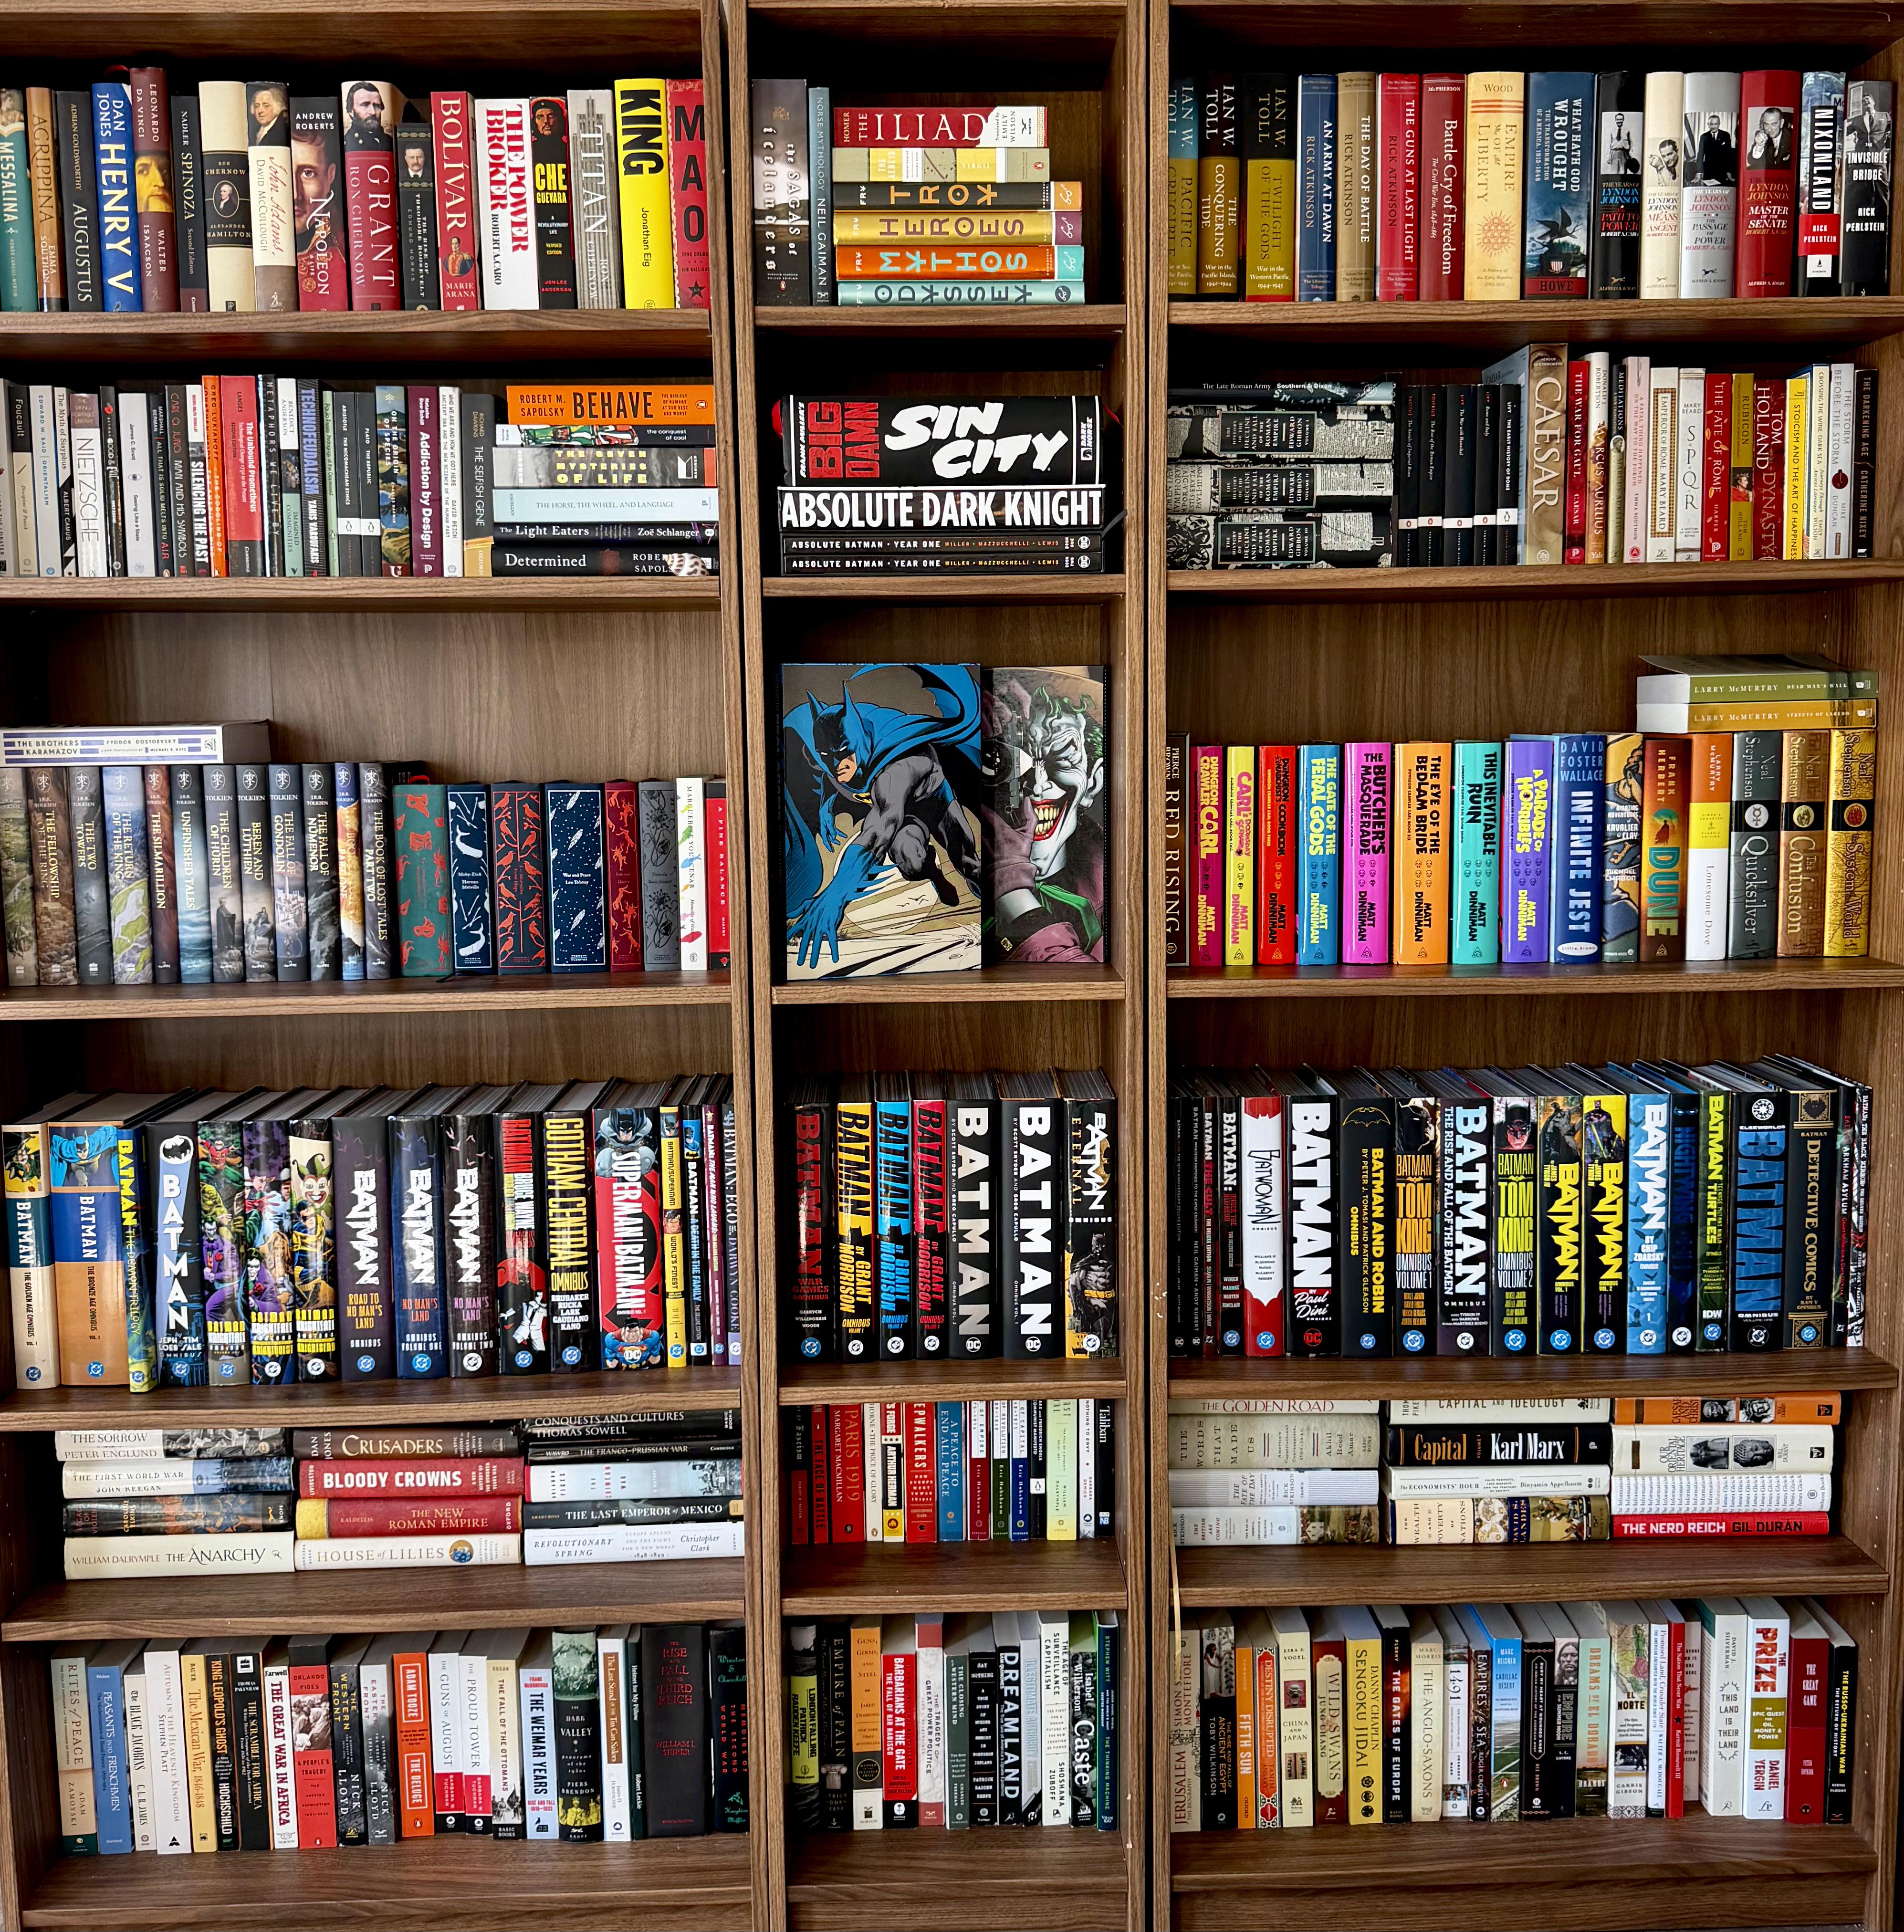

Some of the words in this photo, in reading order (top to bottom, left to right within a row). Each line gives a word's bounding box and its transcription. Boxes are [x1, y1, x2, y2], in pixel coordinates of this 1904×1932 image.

[620, 89, 664, 177] KING
[858, 113, 868, 140] THE
[875, 113, 987, 141] ILIAD
[1324, 120, 1332, 138] AN
[1445, 119, 1458, 161] Battle
[1553, 99, 1568, 191] WROUGHT
[32, 115, 54, 224] AGRIPPINA
[440, 98, 467, 231] BOLÍVAR
[1324, 143, 1332, 179] ARMY
[1812, 109, 1834, 210] NIXONLAND
[1848, 151, 1887, 163] INVISIBLE
[1853, 169, 1882, 180] BRIDGE
[181, 153, 196, 221] SPINOZA
[535, 163, 567, 190] CHE
[580, 125, 607, 236] TITAN
[1324, 183, 1332, 200] AT
[1440, 165, 1458, 193] Cry
[100, 144, 132, 257] HENRY
[536, 192, 567, 204] GUEVARA
[1444, 196, 1457, 210] of
[367, 164, 395, 287] GRANT
[641, 207, 649, 251] Jonathan
[879, 219, 1024, 236] HEROES
[1322, 203, 1332, 243] DAWN
[73, 203, 92, 303] AUGUSTUS
[310, 190, 330, 295] NAPOLEON
[641, 253, 650, 268] Eig
[1442, 213, 1457, 276] Freedom
[108, 269, 134, 294] V
[15, 398, 24, 437] Foucault
[520, 395, 551, 404] ROBERT
[554, 394, 566, 403] M.
[521, 407, 565, 417] SAPOLSKY
[573, 391, 653, 419] BEHAVE
[808, 402, 843, 478] BIG
[845, 402, 880, 478] DAMN
[885, 402, 1004, 450] SIN
[1756, 387, 1769, 470] HOLLAND
[1772, 409, 1782, 445] TOM
[419, 431, 430, 489] Addiction
[932, 430, 1068, 478] CITY
[1532, 376, 1562, 514] CAESAR
[76, 438, 99, 543] NIETZSCHE
[419, 491, 430, 504] by
[420, 504, 432, 548] Design
[782, 492, 914, 528] ABSOLUTE
[923, 492, 997, 526] DARK
[1005, 491, 1101, 525] KNIGHT
[515, 525, 547, 536] Light
[551, 526, 589, 536] Eaters
[638, 528, 654, 537] Zoë
[657, 528, 700, 539] Schlanger
[505, 553, 586, 567] Determined
[1729, 684, 1778, 692] McMURTRY
[1560, 741, 1603, 752] DAVID
[1560, 755, 1603, 766] FOSTER
[1416, 755, 1427, 813] BEDLAM
[1560, 770, 1603, 781] WALLACE
[1360, 765, 1372, 856] MASQUERADE
[1372, 764, 1387, 855] BUTCHER'S
[1466, 783, 1481, 824] RUIN
[1483, 779, 1496, 856] INEVITABLE
[181, 812, 193, 876] UNFINISHED
[1416, 814, 1427, 855] BRIDE
[1569, 790, 1593, 879] INFINITE
[183, 878, 195, 909] TALES
[1647, 846, 1680, 936] DUNE
[1705, 866, 1714, 915] Lonesome
[1568, 888, 1590, 933] JEST
[1704, 920, 1713, 945] Dove
[546, 1118, 586, 1191] GOTHAM
[1633, 1103, 1667, 1229] BATMAN
[1292, 1103, 1331, 1288] BATMAN
[1371, 1148, 1384, 1219] BATMAN
[1396, 1184, 1431, 1217] TOM
[1805, 1140, 1820, 1229] DETECTIVE
[79, 1196, 97, 1259] BATMAN
[345, 1169, 379, 1285] BATMAN
[549, 1197, 588, 1270] CENTRAL
[957, 1107, 989, 1335] BATMAN
[1019, 1107, 1051, 1335] BATMAN
[1350, 1206, 1358, 1256] OMNIBUS
[1396, 1218, 1431, 1253] KING
[1735, 1131, 1785, 1311] BATMAN
[162, 1174, 188, 1330] BATMAN
[1372, 1222, 1384, 1259] AND
[1633, 1253, 1664, 1262] ZDARSKY
[551, 1271, 588, 1291] OMNIBUS
[1804, 1233, 1819, 1292] COMICS
[1294, 1293, 1327, 1306] Paul
[1372, 1260, 1384, 1313] ROBIN
[1297, 1305, 1329, 1319] Dini
[1703, 1310, 1722, 1319] IDW
[1099, 1406, 1110, 1443] Taliban
[1223, 1400, 1283, 1413] GOLDEN
[1288, 1400, 1334, 1412] ROAD
[342, 1435, 443, 1455] CRUSADERS
[535, 1427, 582, 1438] THOMAS
[586, 1426, 627, 1435] SOWELL
[845, 1410, 859, 1458] PARIS
[1415, 1434, 1467, 1464] Capital
[1491, 1432, 1523, 1460] Karl
[1527, 1433, 1565, 1460] Marx
[65, 1451, 99, 1459] PETER
[103, 1449, 157, 1458] ENGLUND
[324, 1472, 388, 1488] BLOODY
[395, 1471, 461, 1487] CROWNS
[846, 1466, 860, 1501] 1919
[565, 1511, 587, 1520] THE
[591, 1510, 617, 1519] LAST
[622, 1507, 670, 1517] EMPEROR
[680, 1505, 722, 1514] MEXICO
[1622, 1523, 1647, 1534] THE
[1650, 1523, 1684, 1534] NERD
[1688, 1522, 1726, 1533] REICH
[1732, 1522, 1753, 1533] GIL
[1757, 1519, 1802, 1532] DURÁN
[166, 1553, 186, 1562] THE
[188, 1548, 265, 1565] ANARCHY
[680, 1534, 720, 1545] Christopher
[73, 1556, 109, 1564] WILLIAM
[112, 1555, 160, 1563] DALRYMPLE
[1754, 1627, 1778, 1692] PRIZE
[440, 1675, 448, 1707] GUNS
[1356, 1649, 1367, 1723] SENGOKU
[103, 1692, 115, 1738] PEASANTS
[443, 1709, 449, 1718] OF
[1618, 1701, 1644, 1710] NORTE
[1719, 1705, 1738, 1713] LAND
[442, 1720, 453, 1766] AUGUST
[1003, 1651, 1019, 1799] DREAMLAND
[1240, 1714, 1251, 1747] FIFTH
[1718, 1729, 1738, 1737] THEIR
[1074, 1719, 1095, 1786] Caste
[1241, 1750, 1252, 1775] SUN
[1354, 1726, 1368, 1767] JIDAI
[1718, 1741, 1738, 1749] LAND
[1754, 1759, 1765, 1791] YERGIN
[1768, 1760, 1779, 1790] DANIEL
[219, 1783, 232, 1835] HOCHSCHILD
